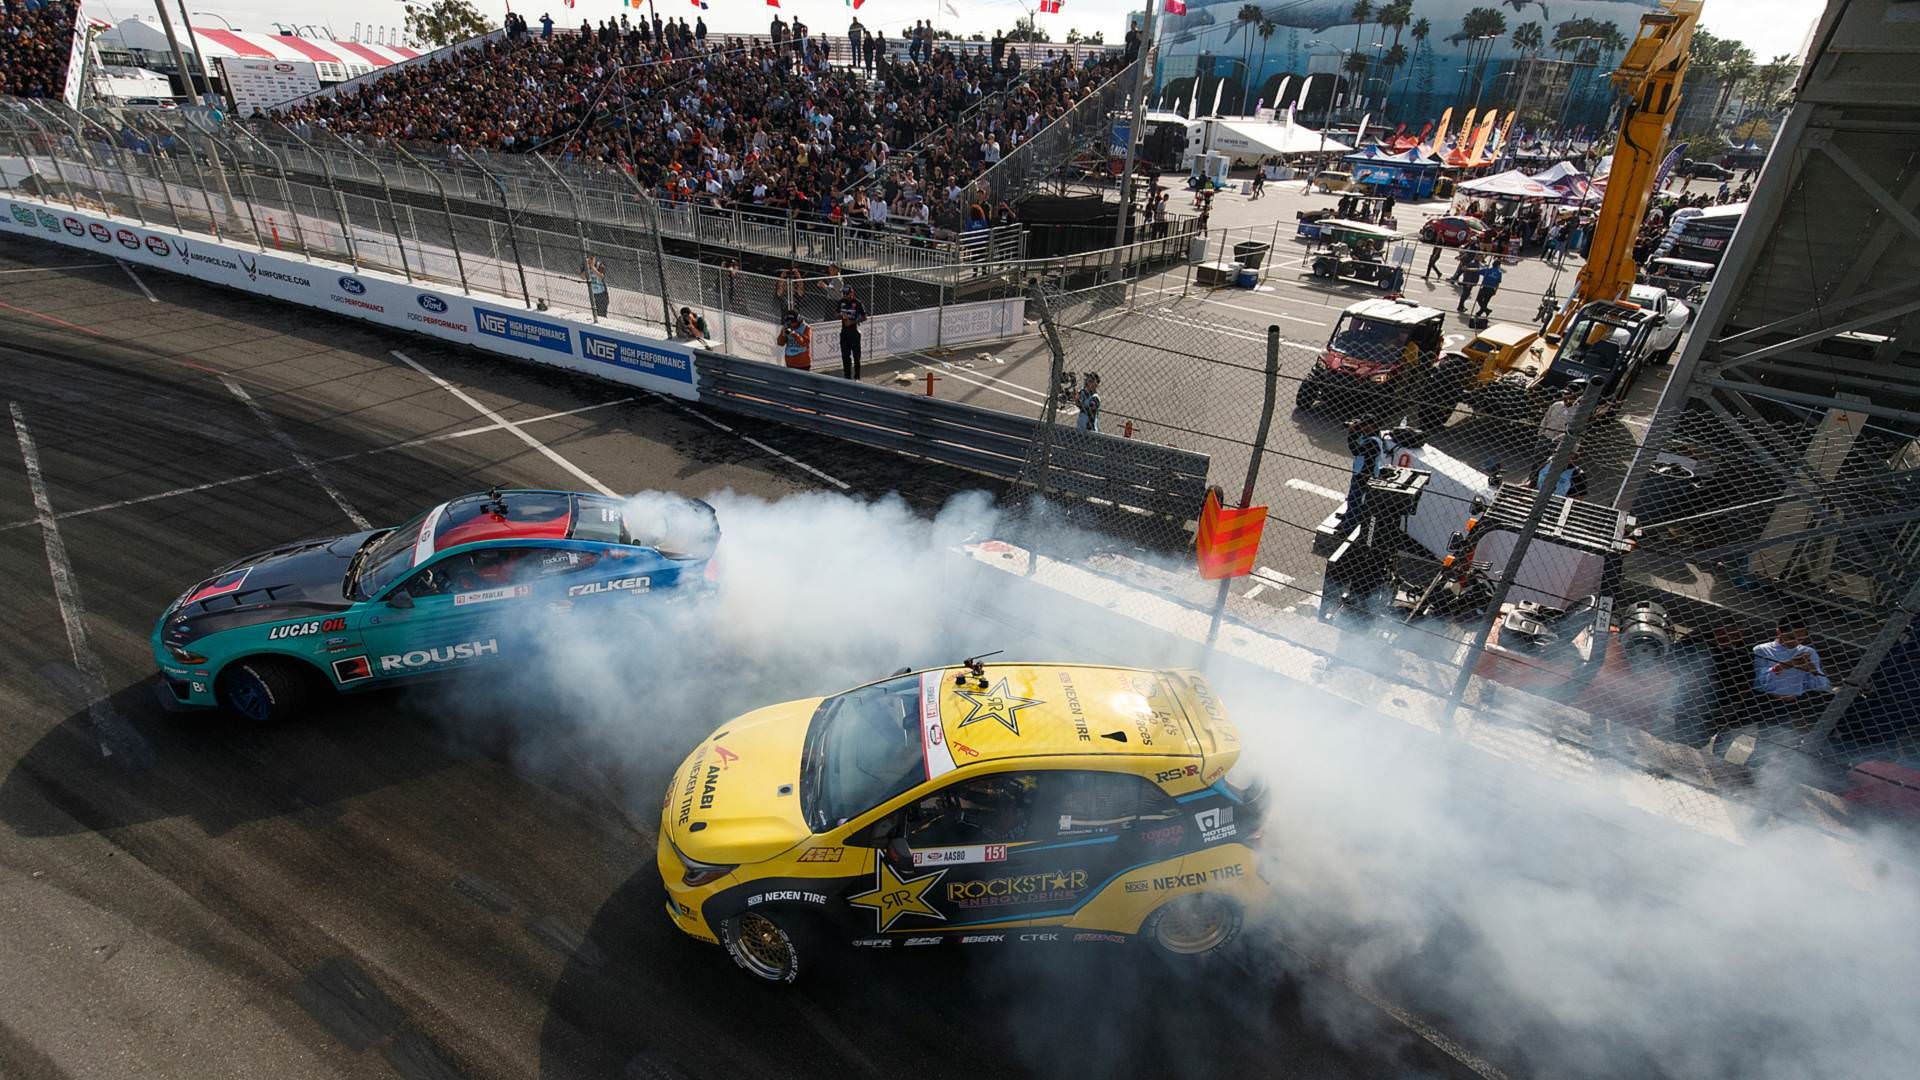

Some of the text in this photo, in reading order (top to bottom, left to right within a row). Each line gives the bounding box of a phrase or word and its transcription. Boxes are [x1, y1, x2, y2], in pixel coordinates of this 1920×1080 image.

[118, 231, 136, 242] Black
[148, 238, 166, 249] Black
[190, 253, 237, 270] AIRFORCE.COM
[258, 269, 311, 287] AIRFORCE.COM
[343, 280, 362, 293] Ford
[331, 294, 385, 313] FORD PERFORMANCE
[423, 296, 442, 310] Ford
[407, 312, 468, 332] FORD PERFORMANCE
[479, 312, 507, 334] NOS
[509, 320, 567, 342] HIGH PERFORMANCE
[586, 337, 618, 361] NOS
[620, 346, 686, 370] HIGH PERFORMANCE
[568, 576, 651, 597] FALKEN
[269, 616, 346, 640] LUCAS OIL
[380, 638, 498, 671] ROUSH
[1063, 684, 1082, 715] NEXEN
[1075, 716, 1091, 743] TIRE
[679, 761, 704, 827] NEXEN TIRE
[700, 765, 720, 809] ANABI
[1141, 825, 1184, 840] TOYOTA
[1202, 824, 1236, 838] MOTEGI
[1204, 829, 1237, 843] RACING
[797, 847, 844, 863] AEM
[986, 845, 1006, 860] 151
[948, 869, 1088, 902] ROCKSTAR
[1153, 871, 1207, 891] NEXEN
[1209, 863, 1245, 882] TIRE
[765, 890, 801, 902] NEXEN
[802, 891, 828, 905] TIRE
[959, 888, 1075, 908] ENERGY DRINK
[968, 934, 1006, 943] BERK
[1019, 933, 1059, 941] CTEK
